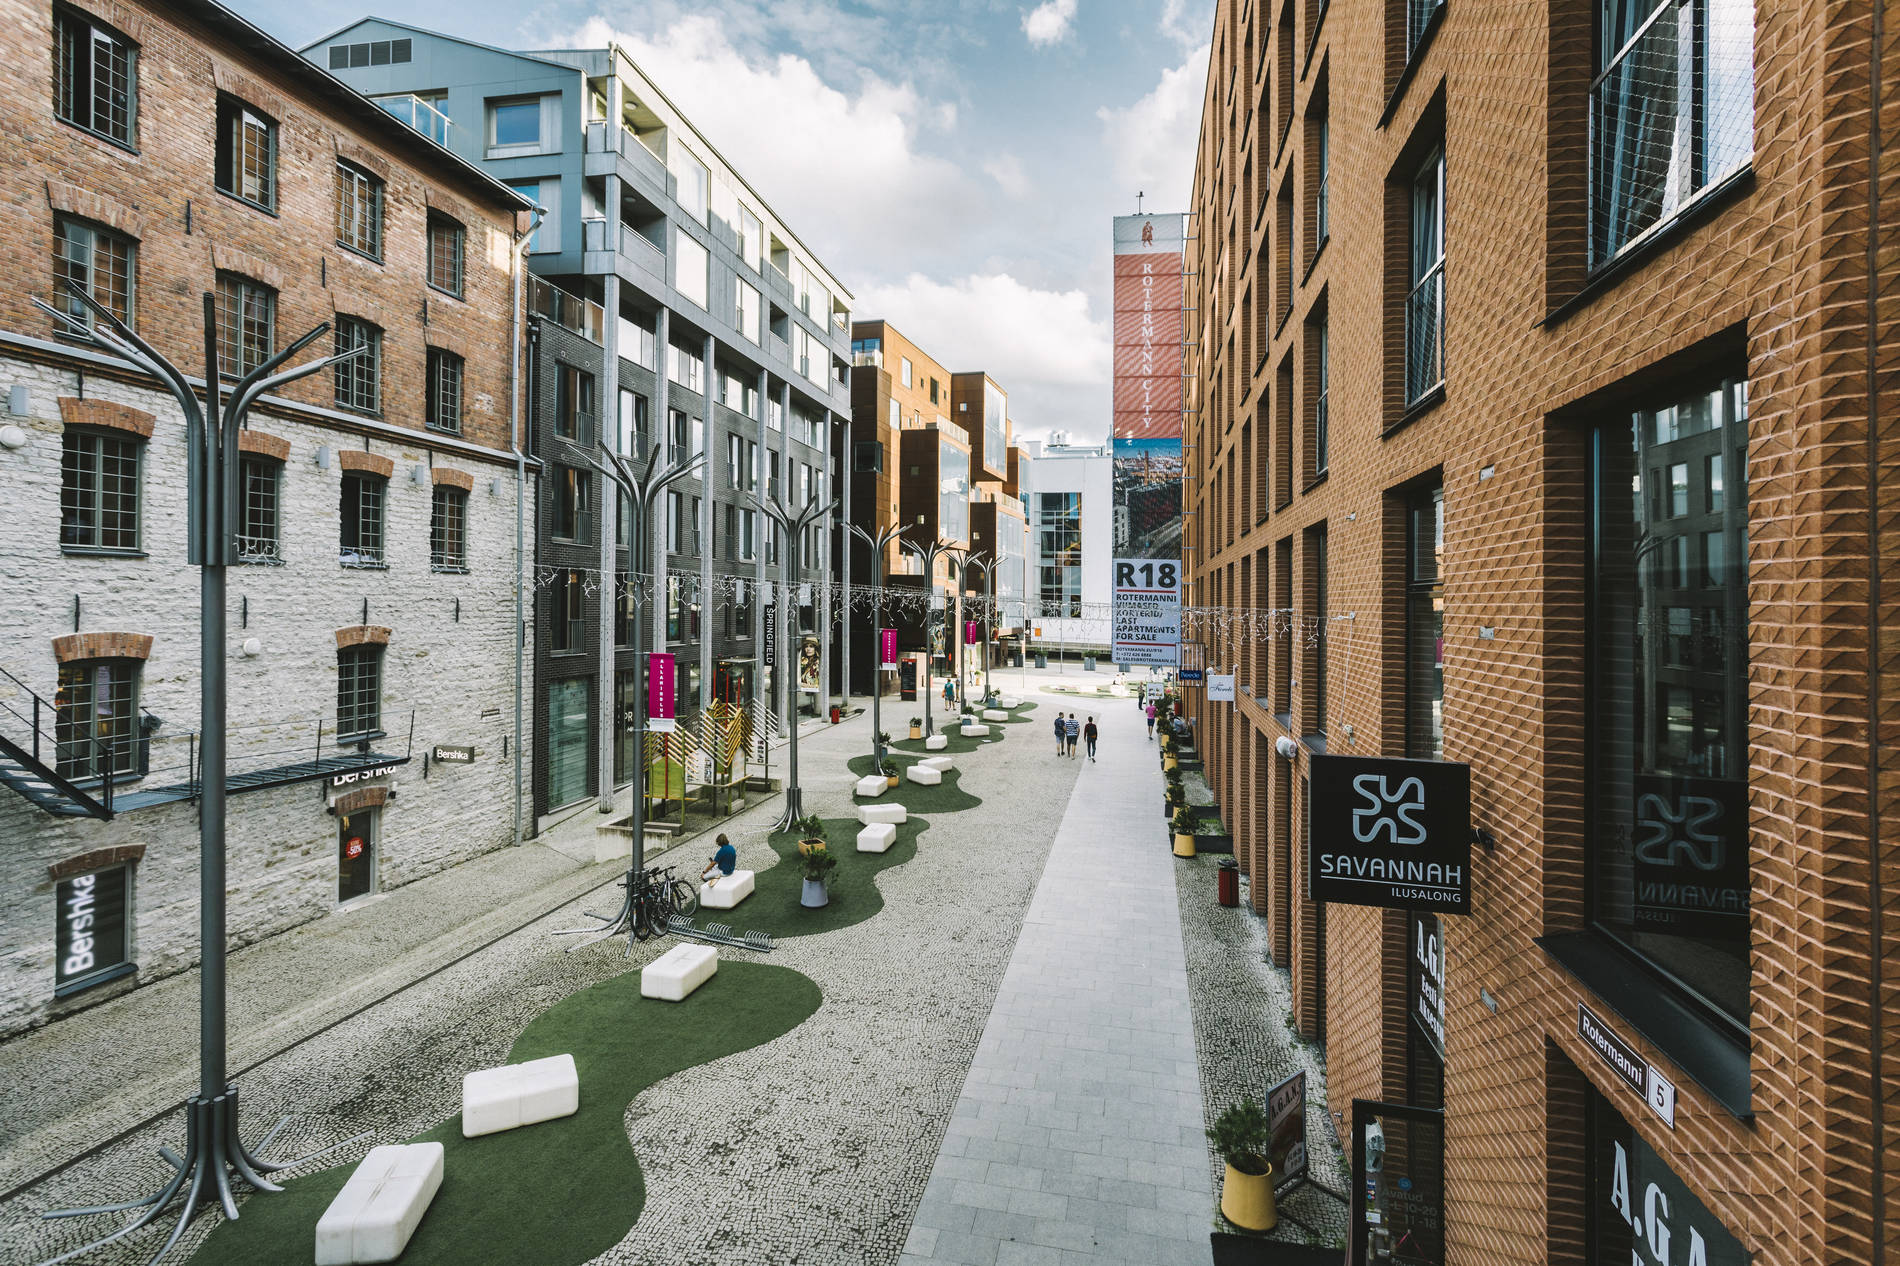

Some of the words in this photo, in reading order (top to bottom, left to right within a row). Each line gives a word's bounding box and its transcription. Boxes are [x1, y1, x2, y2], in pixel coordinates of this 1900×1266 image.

[1141, 263, 1154, 375] ROTERMANN
[1142, 379, 1153, 428] CITY
[1116, 562, 1177, 589] R18
[1116, 594, 1177, 602] ROTERMANNI
[766, 607, 774, 664] SPRINGFIELD
[1116, 626, 1176, 634] APARTMENTS
[1116, 633, 1134, 641] FOR
[437, 749, 469, 760] Bershka
[1320, 854, 1461, 885] SAVANNAH
[1391, 887, 1461, 903] ILUSALONG
[64, 874, 96, 976] Bershka
[1582, 1015, 1643, 1086] Rotermanni
[1656, 1084, 1665, 1108] 5
